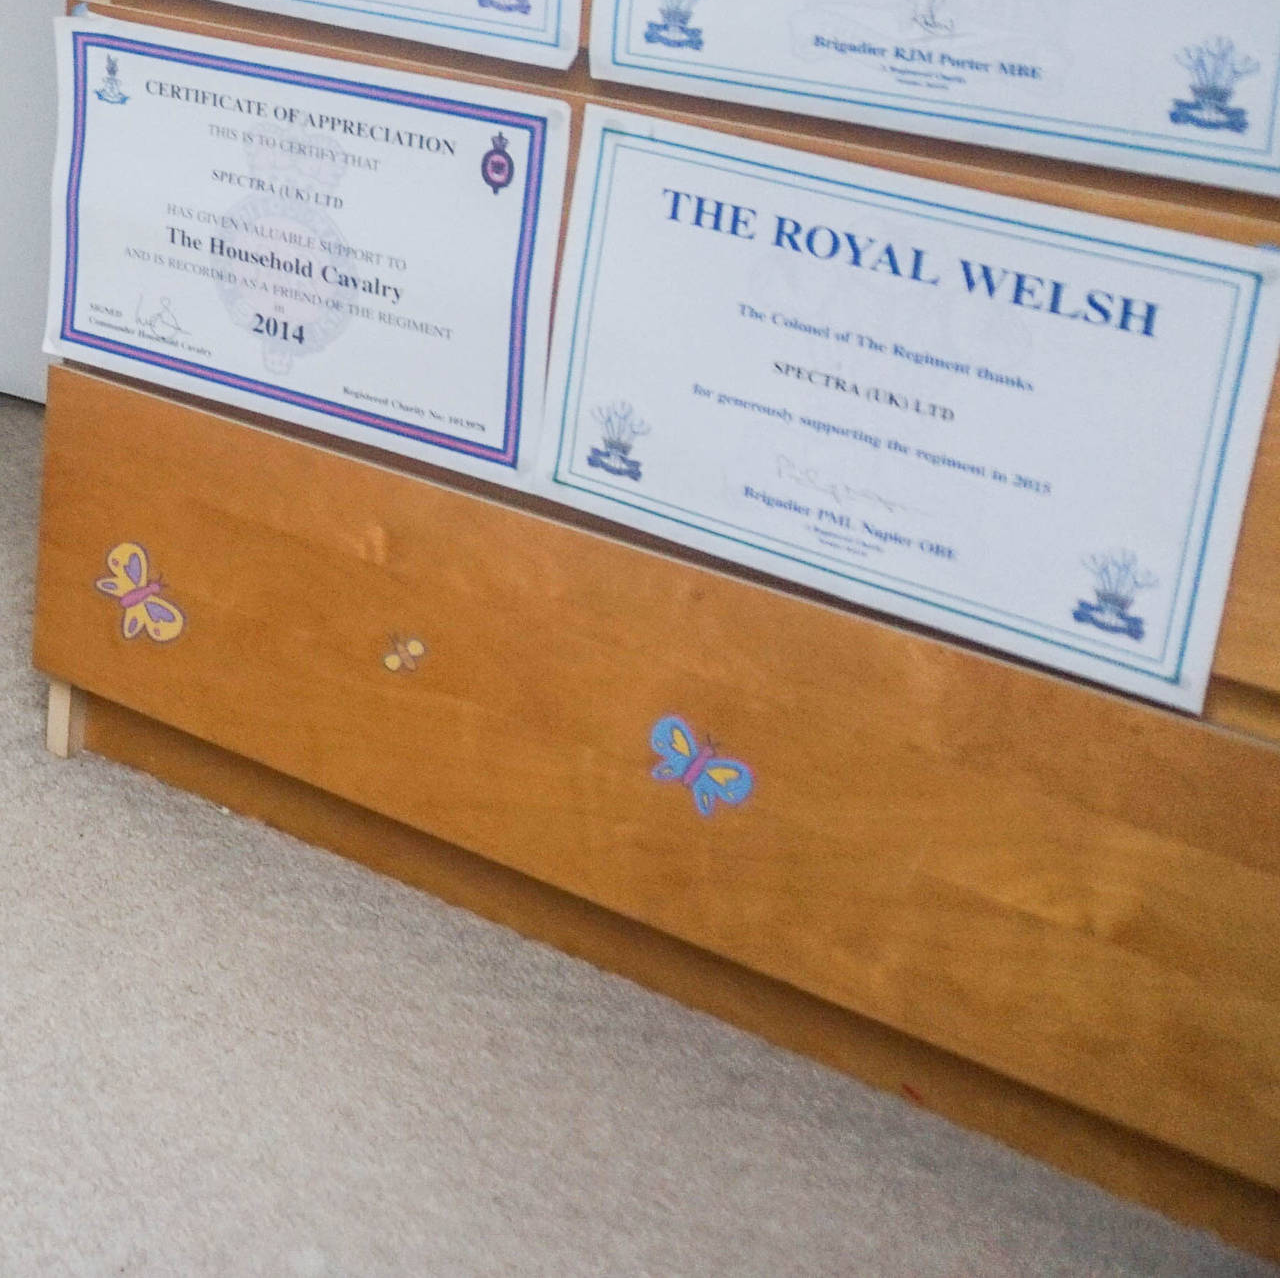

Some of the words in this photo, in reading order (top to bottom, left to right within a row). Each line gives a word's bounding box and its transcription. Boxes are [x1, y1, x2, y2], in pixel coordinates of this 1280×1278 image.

[813, 34, 887, 61] Brigadier
[939, 53, 991, 77] Porter
[144, 79, 269, 119] CERTIFICATE
[274, 106, 300, 124] OF
[304, 111, 457, 156] APPRECIATION
[208, 124, 238, 139] THIS
[242, 130, 254, 142] IS
[258, 133, 276, 147] TO
[279, 137, 339, 161] CERTIFY
[342, 152, 380, 173] THAT
[212, 169, 275, 195] SPECTRA
[278, 184, 311, 202] (UK)
[315, 193, 343, 210] LTD
[166, 202, 193, 218] HAS
[197, 208, 241, 230] GIVEN
[244, 218, 316, 250] VALUABLE
[320, 236, 382, 265] SUPPORT
[386, 255, 407, 271] TO
[166, 226, 203, 251] The
[209, 235, 313, 279] Household
[321, 264, 404, 303] Cavalry
[662, 188, 756, 240] THE
[773, 217, 940, 287] ROYAL
[959, 259, 1161, 337] WELSH
[124, 247, 150, 263] AND
[153, 252, 165, 265] IS
[168, 256, 237, 286] RECORDED
[240, 276, 257, 290] AS
[260, 281, 270, 293] A
[273, 283, 323, 307] FRIEND
[325, 295, 342, 311] OF
[348, 302, 375, 321] THE
[379, 310, 454, 342] REGIMENT
[251, 313, 305, 345] 2014
[738, 303, 766, 321] The
[770, 311, 831, 339] Colonel
[836, 330, 852, 343] of
[856, 332, 887, 354] The
[892, 340, 971, 375] Regiment
[975, 363, 1034, 392] thanks
[772, 360, 859, 397] SPECTRA
[865, 385, 910, 413] (UK)
[913, 401, 955, 422] LTD
[693, 383, 713, 399] for
[717, 391, 794, 424] generously
[799, 412, 882, 449] supporting
[887, 435, 911, 455] the
[914, 443, 987, 477] regiment
[991, 466, 1007, 483] in
[1012, 474, 1051, 496] 2015
[743, 485, 810, 519] Brigadier
[862, 517, 914, 550] Napier
